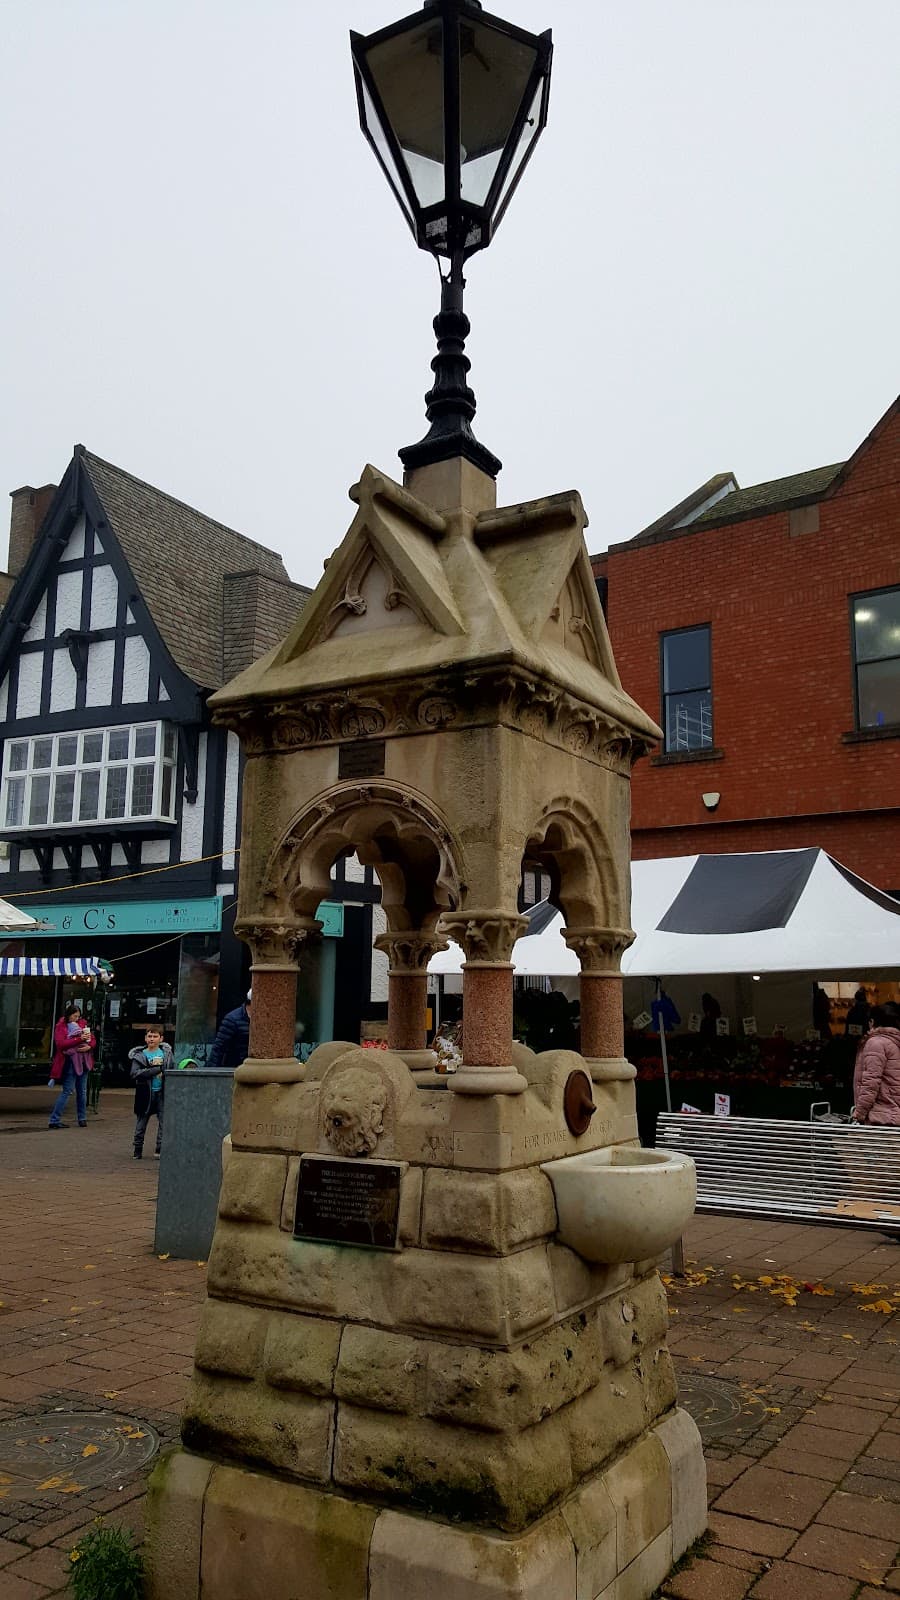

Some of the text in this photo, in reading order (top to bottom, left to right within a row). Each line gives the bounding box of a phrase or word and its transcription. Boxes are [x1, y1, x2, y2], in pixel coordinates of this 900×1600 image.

[62, 915, 73, 930] &
[83, 908, 116, 930] C's
[523, 1134, 540, 1149] FOR
[543, 1129, 568, 1145] PRAISE
